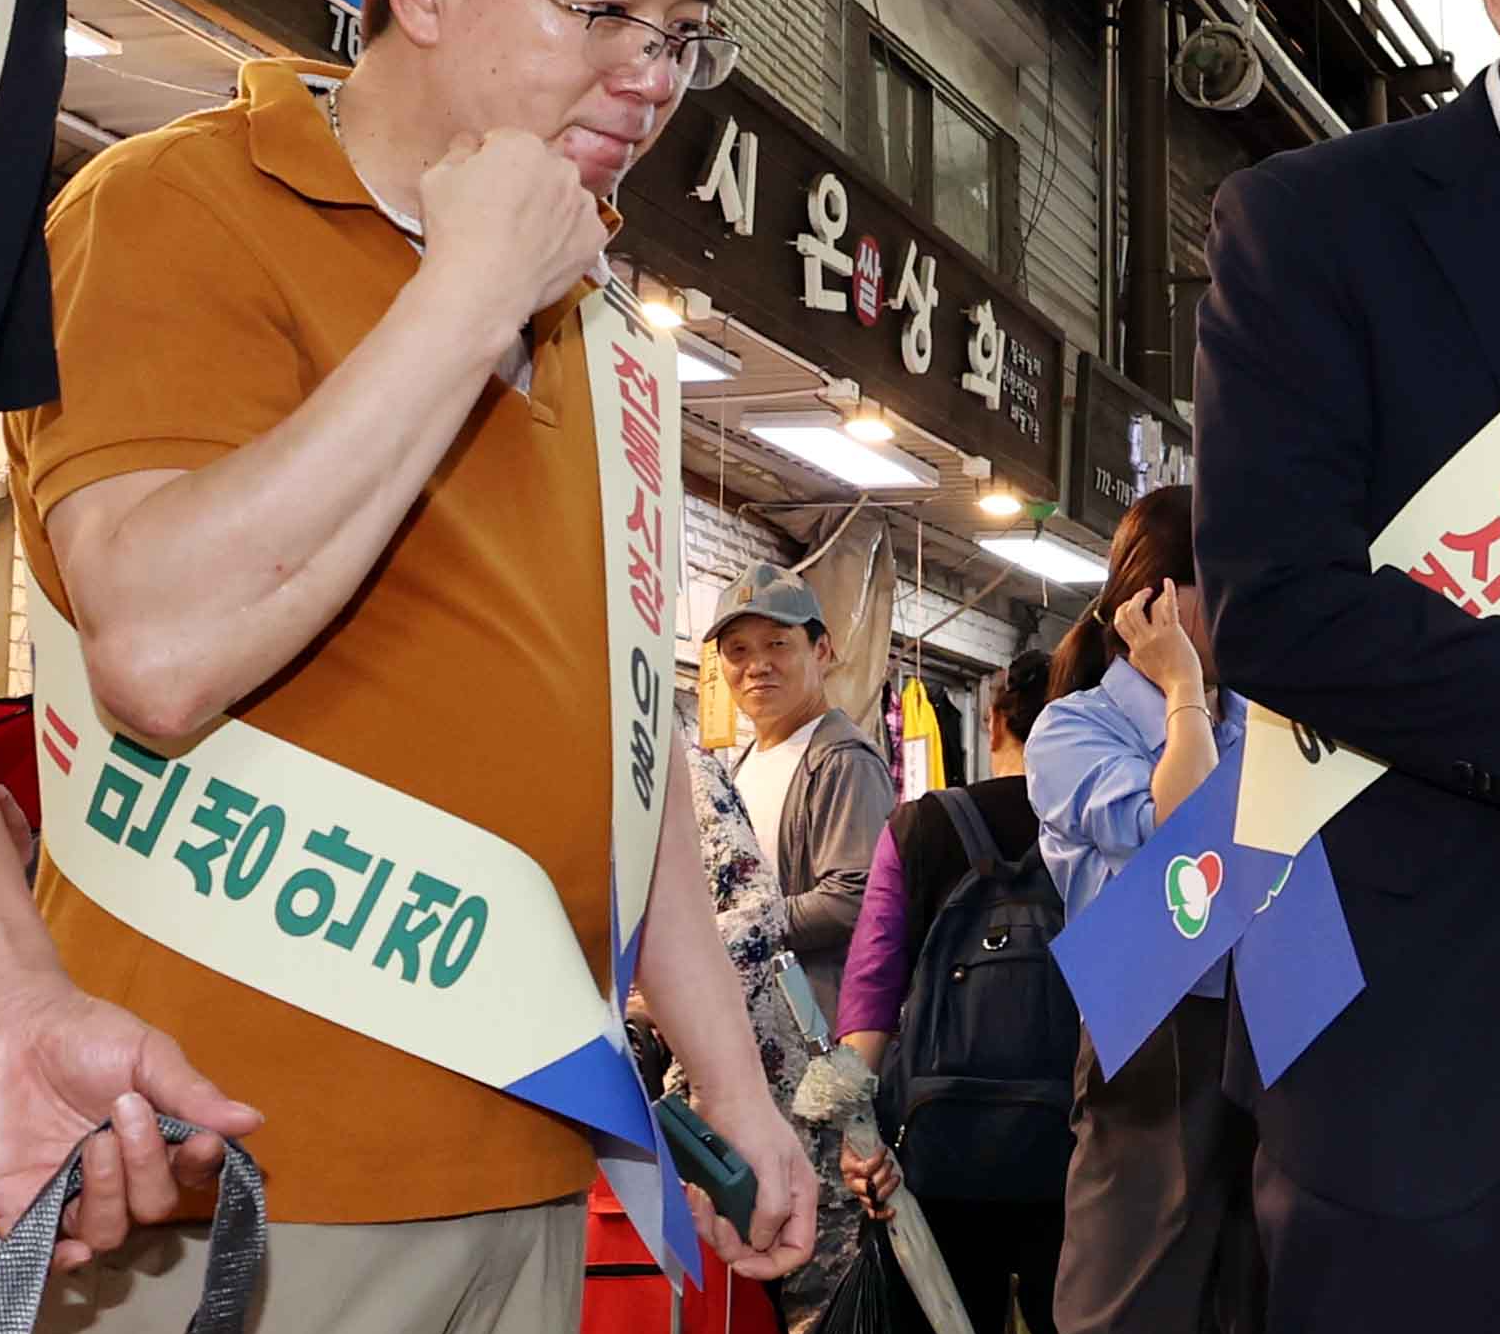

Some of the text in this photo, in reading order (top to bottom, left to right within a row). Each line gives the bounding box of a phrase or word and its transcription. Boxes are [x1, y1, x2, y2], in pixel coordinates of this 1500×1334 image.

[611, 341, 665, 637] 전통시장
[630, 646, 660, 812] 이용
[85, 731, 490, 989] 민생안정
